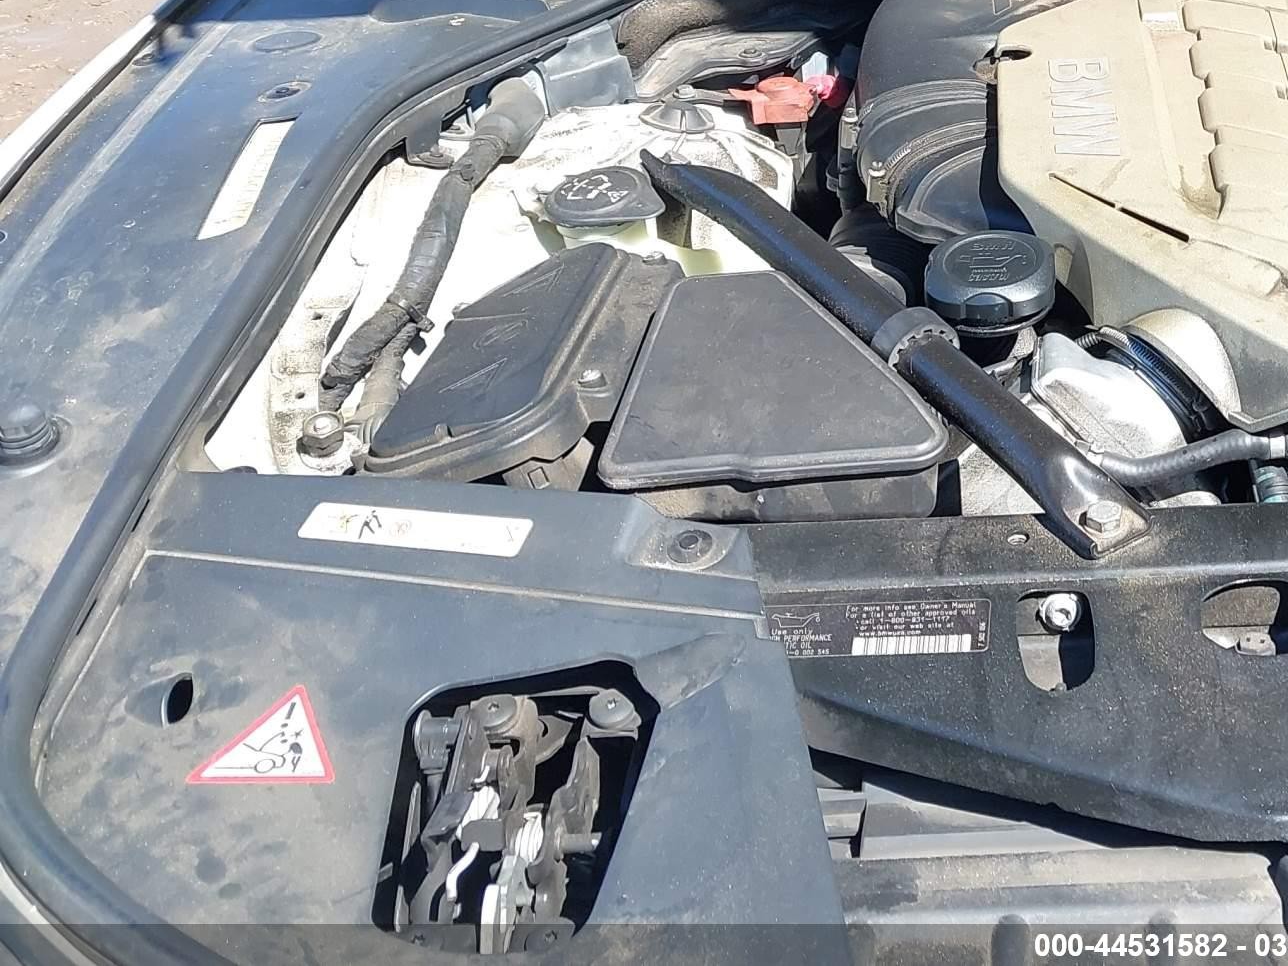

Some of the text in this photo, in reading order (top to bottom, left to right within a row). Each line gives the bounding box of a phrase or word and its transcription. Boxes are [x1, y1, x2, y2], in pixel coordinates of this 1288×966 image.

[1047, 58, 1121, 156] BMW
[951, 601, 977, 610] Manual
[924, 609, 958, 617] approved
[961, 608, 976, 616] oils
[860, 617, 875, 625] call
[793, 627, 813, 637] only
[783, 633, 833, 643] PERFORMANCE
